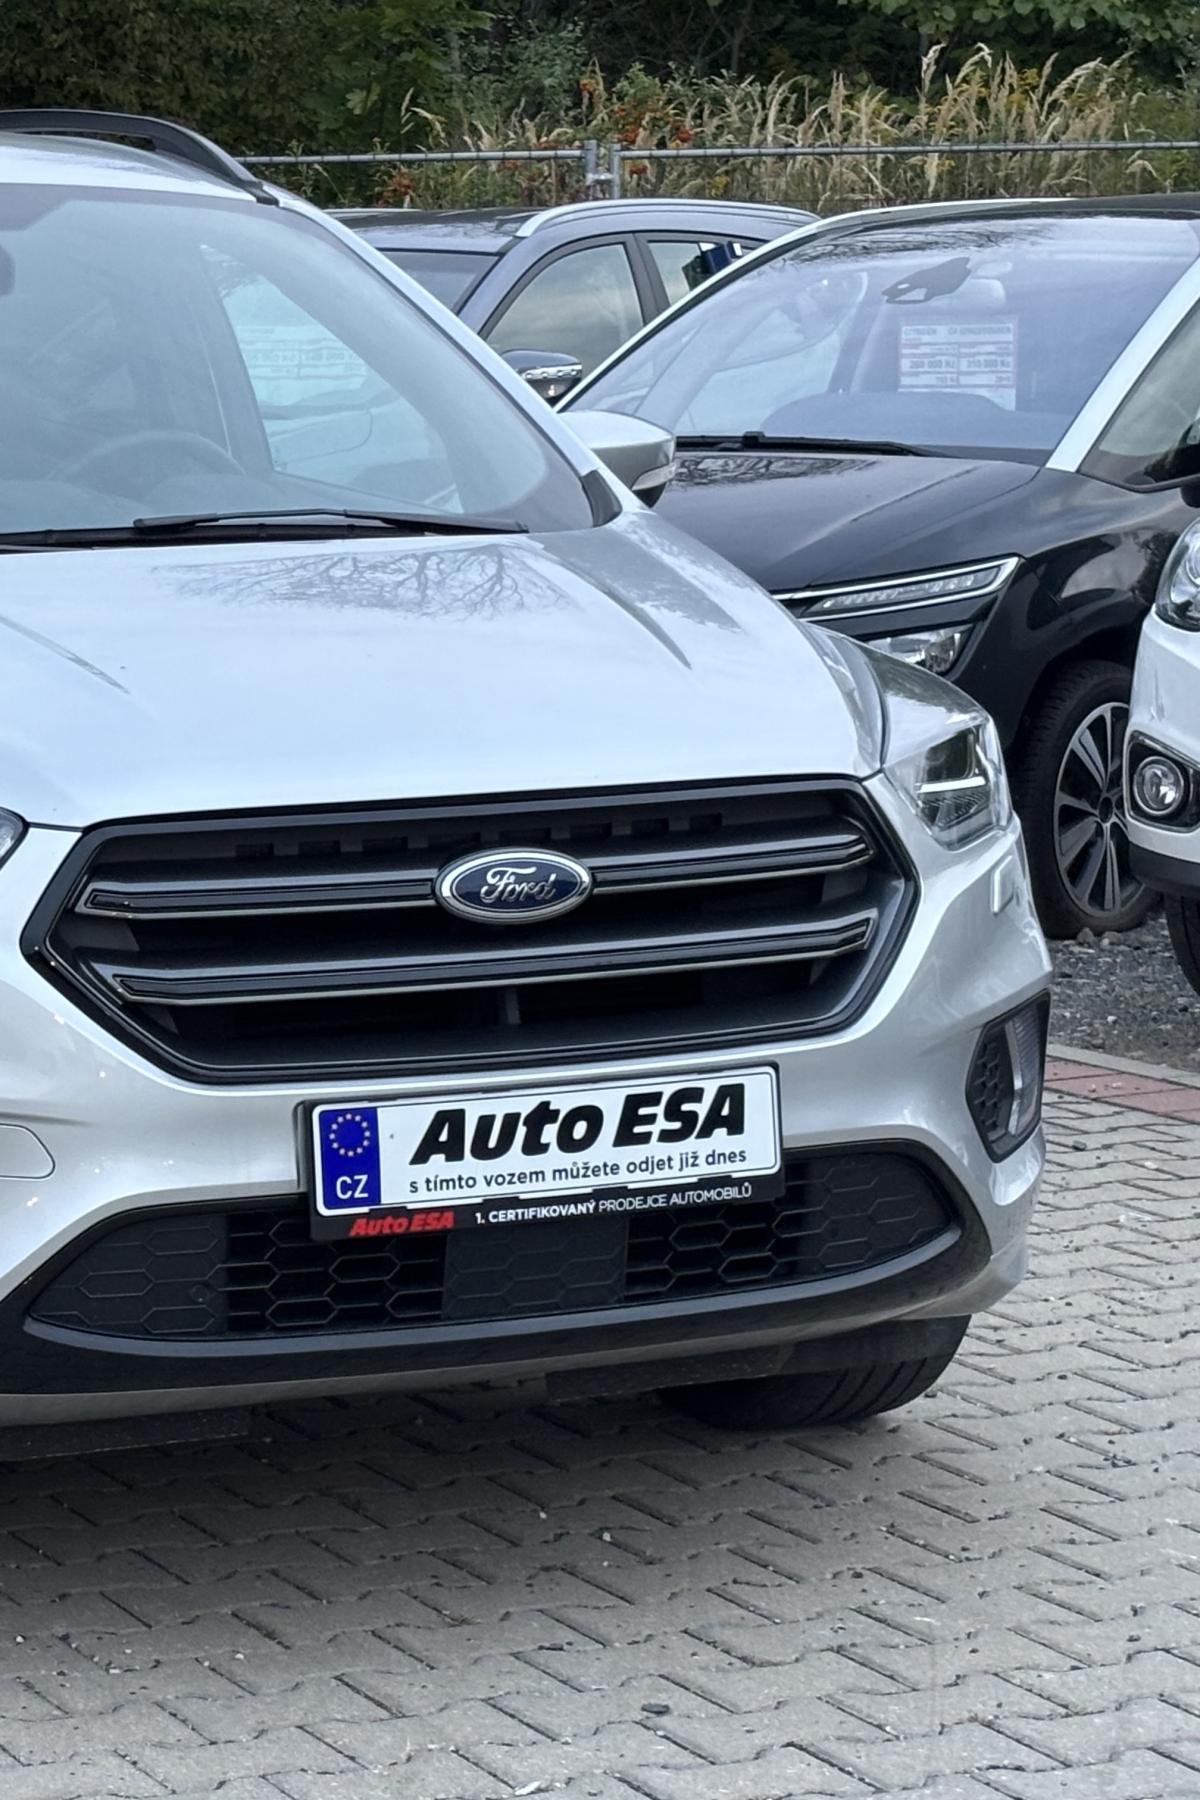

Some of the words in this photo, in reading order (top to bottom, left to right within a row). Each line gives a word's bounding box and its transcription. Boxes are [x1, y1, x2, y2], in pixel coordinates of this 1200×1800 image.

[480, 866, 557, 904] Ford
[409, 1100, 604, 1166] Auto
[612, 1083, 745, 1148] ESA
[336, 1174, 369, 1200] CZ
[409, 1180, 419, 1193] s
[425, 1174, 477, 1192] tímto
[483, 1170, 546, 1188] vozem
[552, 1161, 620, 1182] můžete
[626, 1155, 674, 1175] odjet
[678, 1151, 700, 1172] již
[705, 1149, 747, 1166] dnes
[348, 1215, 408, 1237] Auto
[409, 1210, 455, 1232] ESA
[475, 1212, 485, 1225] 1.
[489, 1200, 596, 1223] CERTIFIKOVANÝ
[599, 1193, 668, 1212] PRODEJCE
[669, 1182, 752, 1206] AUTOMOBILŮ
